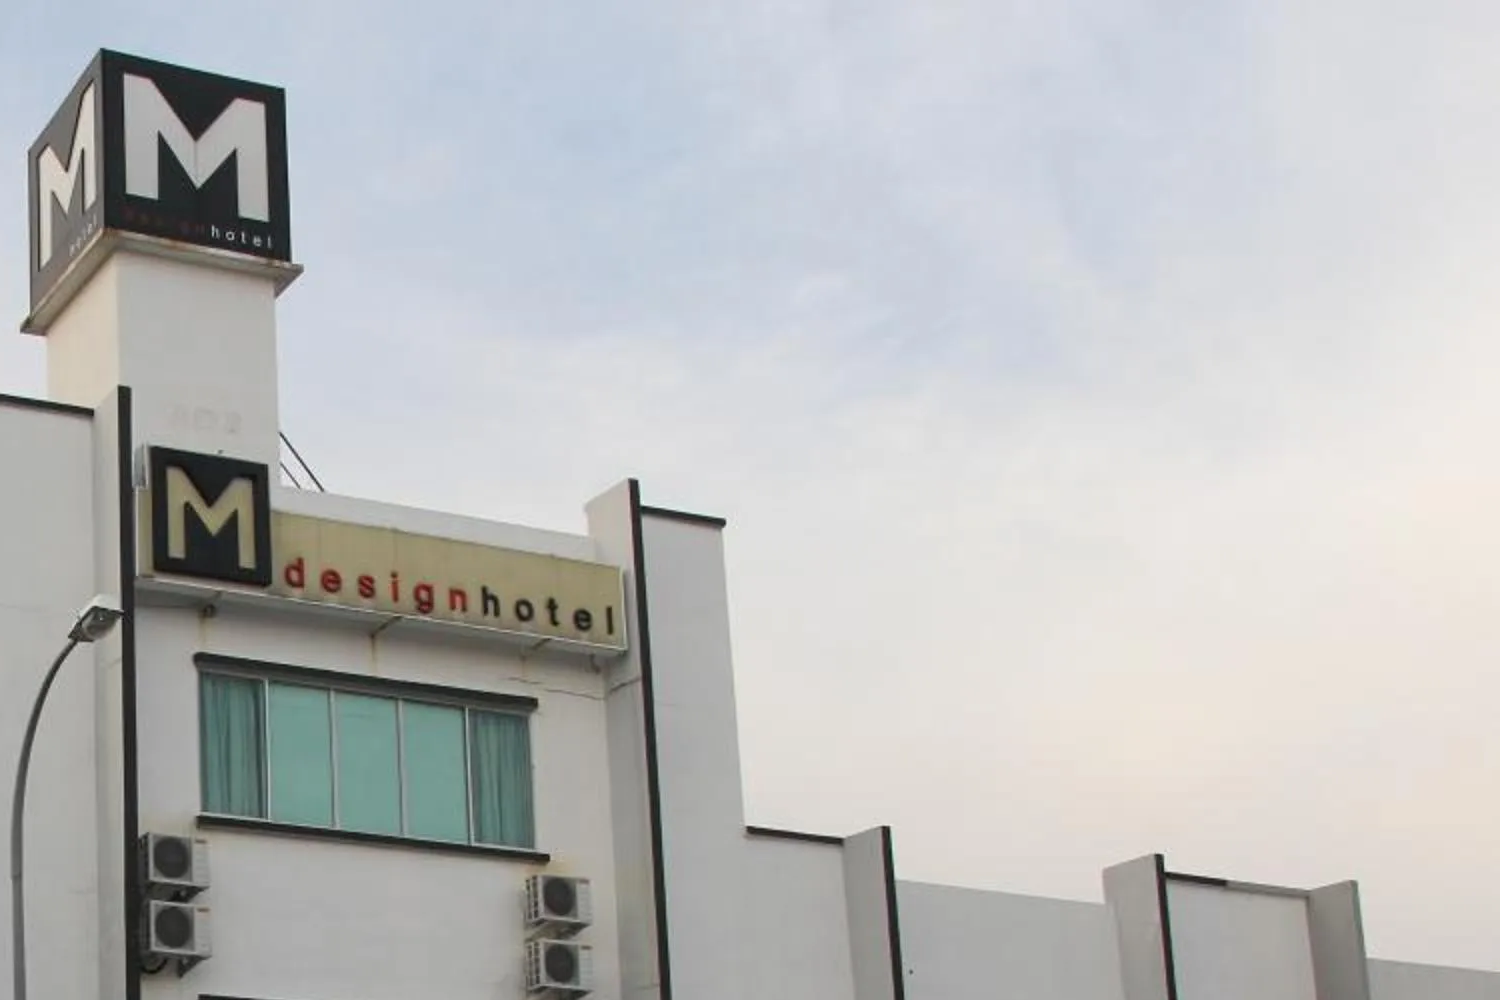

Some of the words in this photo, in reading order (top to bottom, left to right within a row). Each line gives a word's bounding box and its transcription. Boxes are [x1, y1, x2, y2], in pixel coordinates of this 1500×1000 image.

[39, 80, 97, 269] M
[123, 72, 270, 223] M
[210, 224, 273, 249] hotel
[166, 466, 257, 570] M
